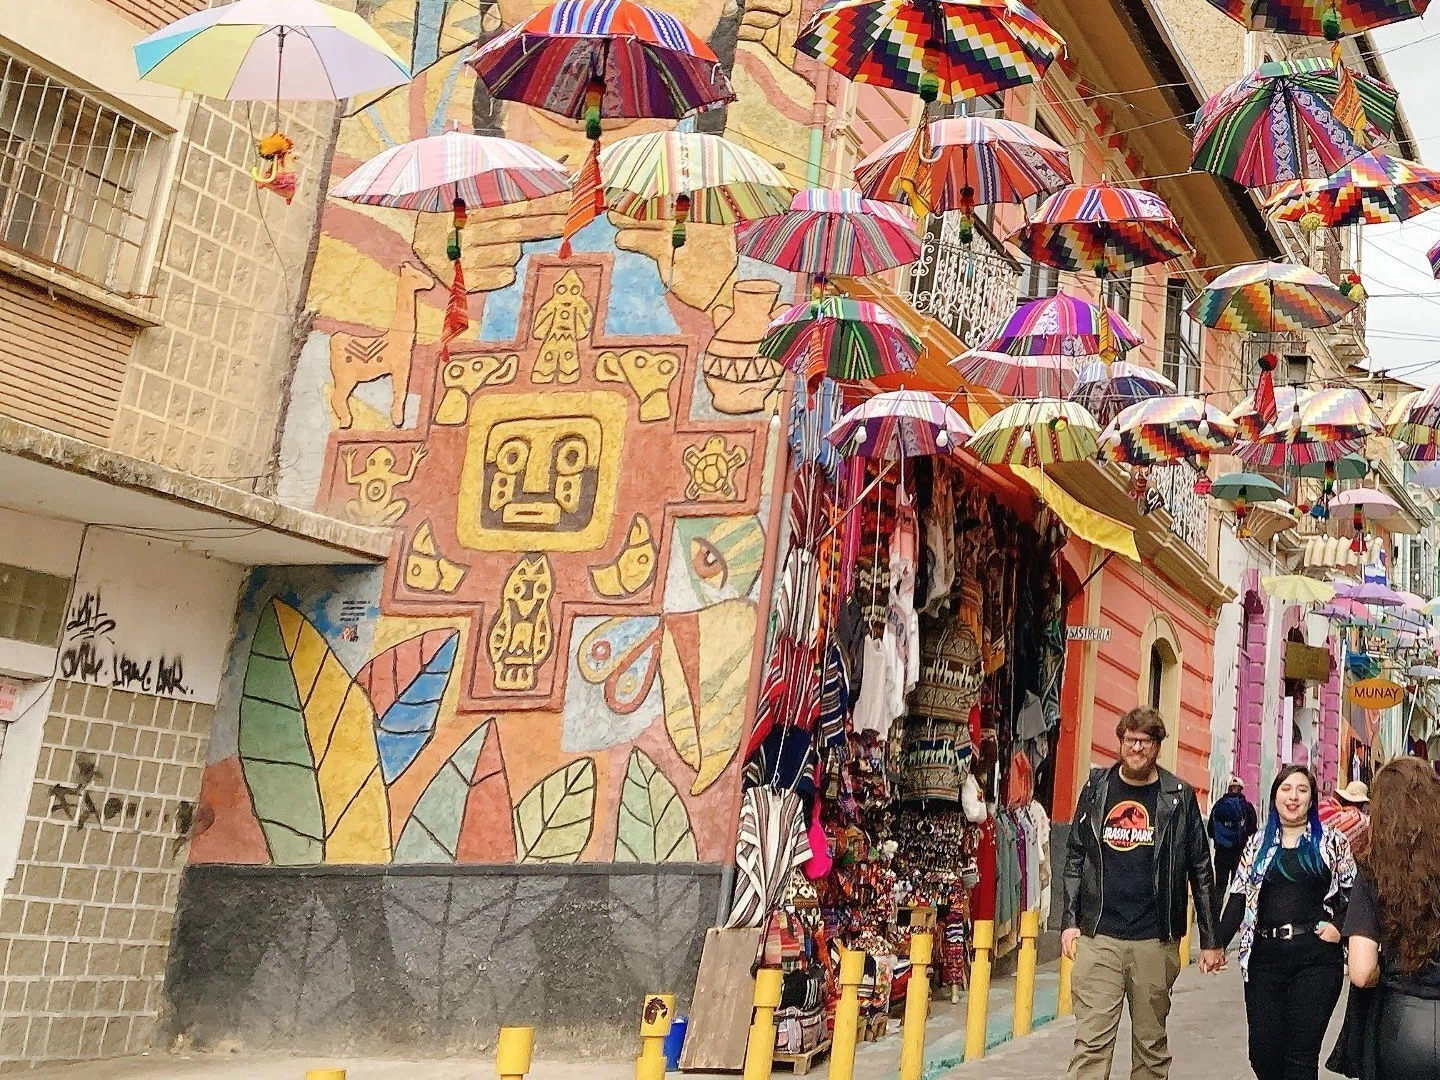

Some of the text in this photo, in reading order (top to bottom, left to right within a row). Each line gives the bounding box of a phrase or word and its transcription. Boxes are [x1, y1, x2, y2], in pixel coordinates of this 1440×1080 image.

[1068, 626, 1112, 641] SASTRERIA
[1354, 686, 1400, 702] MUNAY
[1130, 827, 1154, 843] PARK
